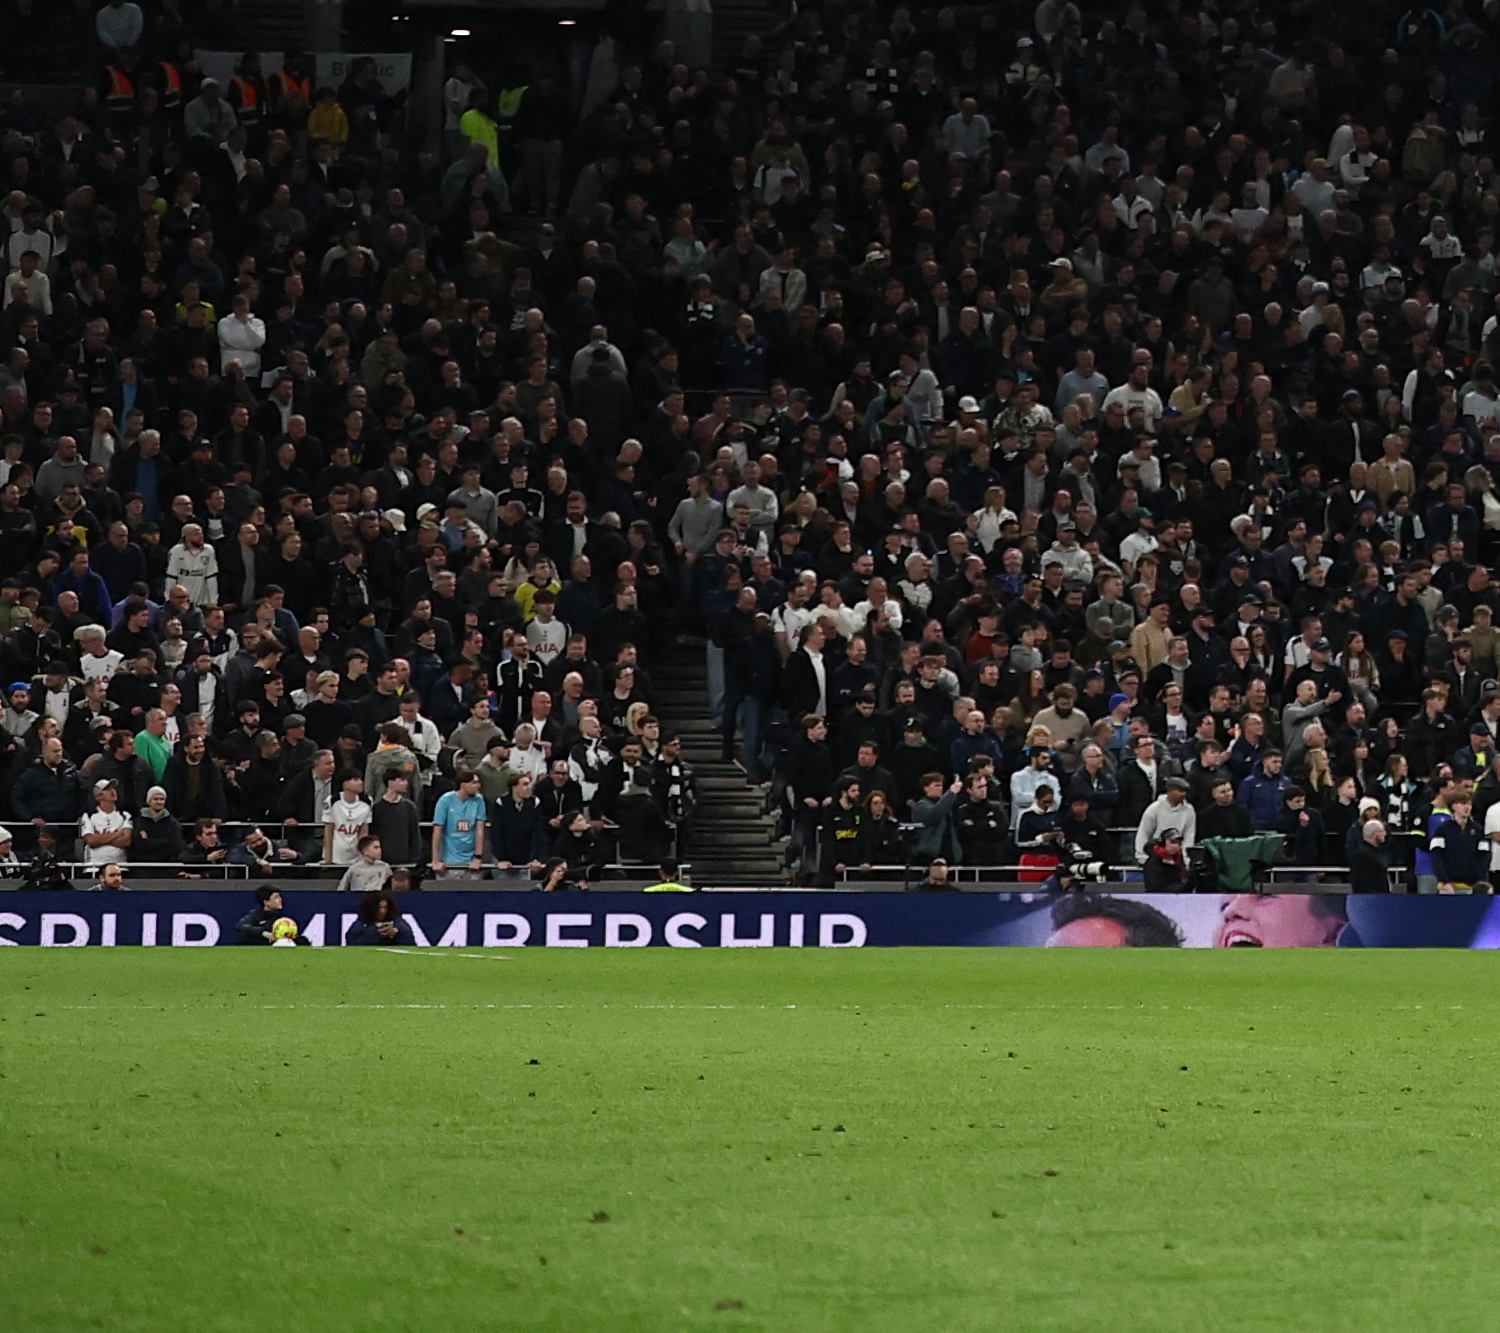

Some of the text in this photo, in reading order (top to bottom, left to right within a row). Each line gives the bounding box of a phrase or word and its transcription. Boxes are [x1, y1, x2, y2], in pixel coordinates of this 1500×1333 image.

[535, 643, 559, 655] AIA
[338, 823, 362, 836] AIA
[300, 912, 868, 948] MBERSHIP
